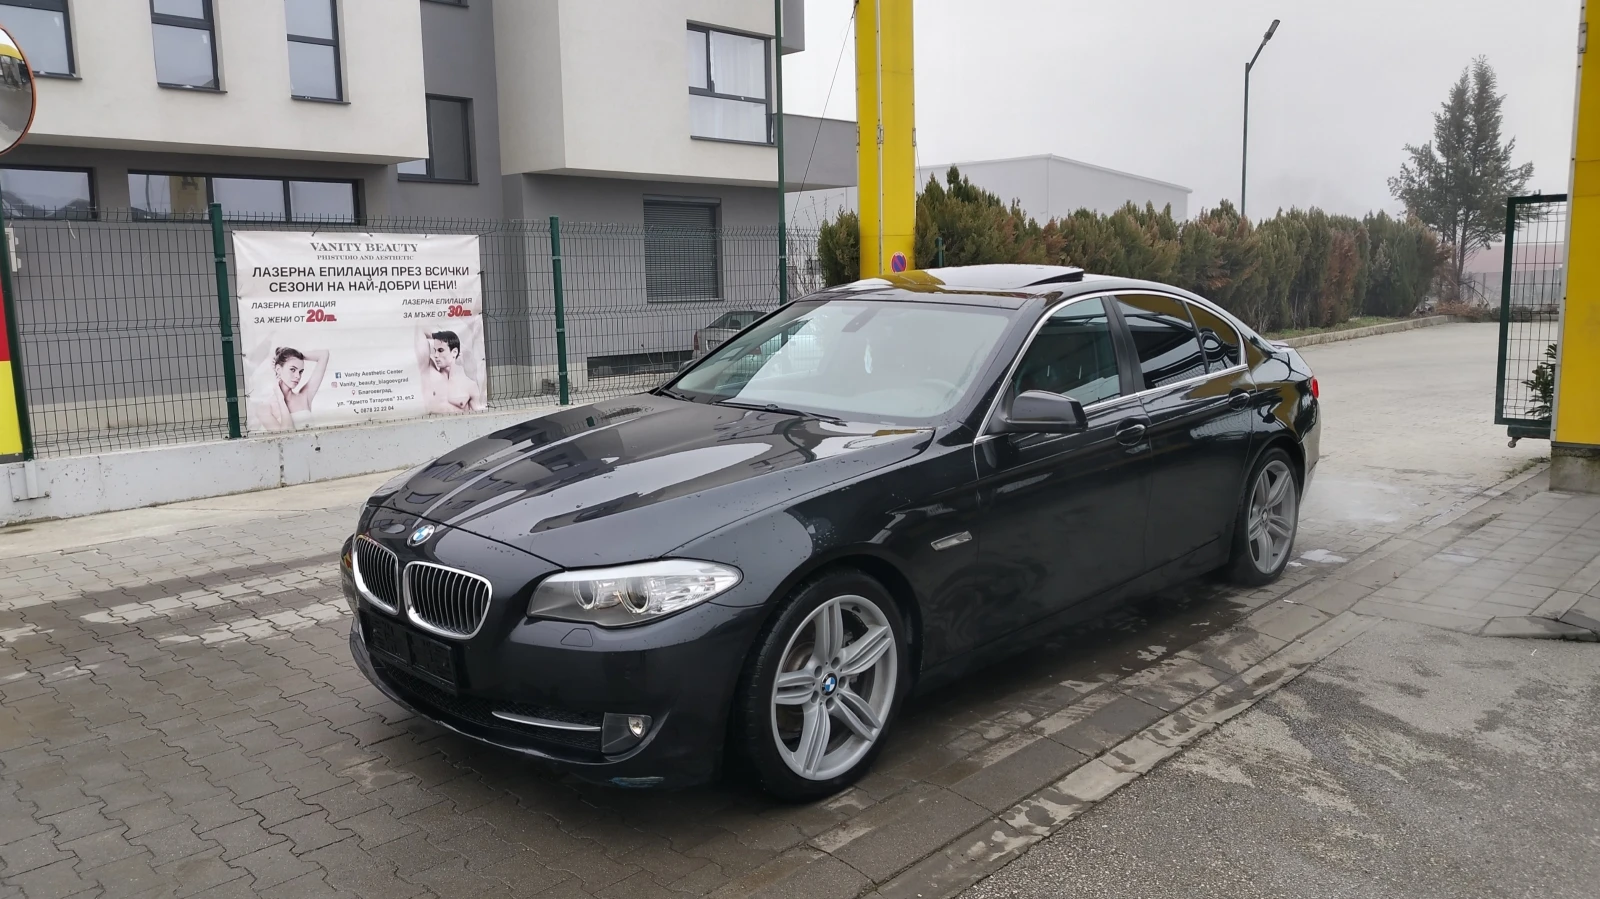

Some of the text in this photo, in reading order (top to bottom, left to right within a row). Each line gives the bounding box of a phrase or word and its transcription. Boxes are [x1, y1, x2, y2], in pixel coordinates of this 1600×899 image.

[310, 242, 418, 252] VANITY BEAUTY
[252, 266, 469, 279] ЛАЗЕРНА ЕПИЛАЦИЯ ПРЕЗ ВСИЧКИ
[269, 278, 457, 293] СЕЗОНИ НА НАЙ-ДОБРИ ЦЕНИ!
[292, 300, 336, 309] ЕПИЛАЦИЯ
[435, 297, 473, 305] ЕПИЛАЦИЯ
[267, 316, 292, 324] ЖЕНИ
[294, 315, 305, 323] ОТ
